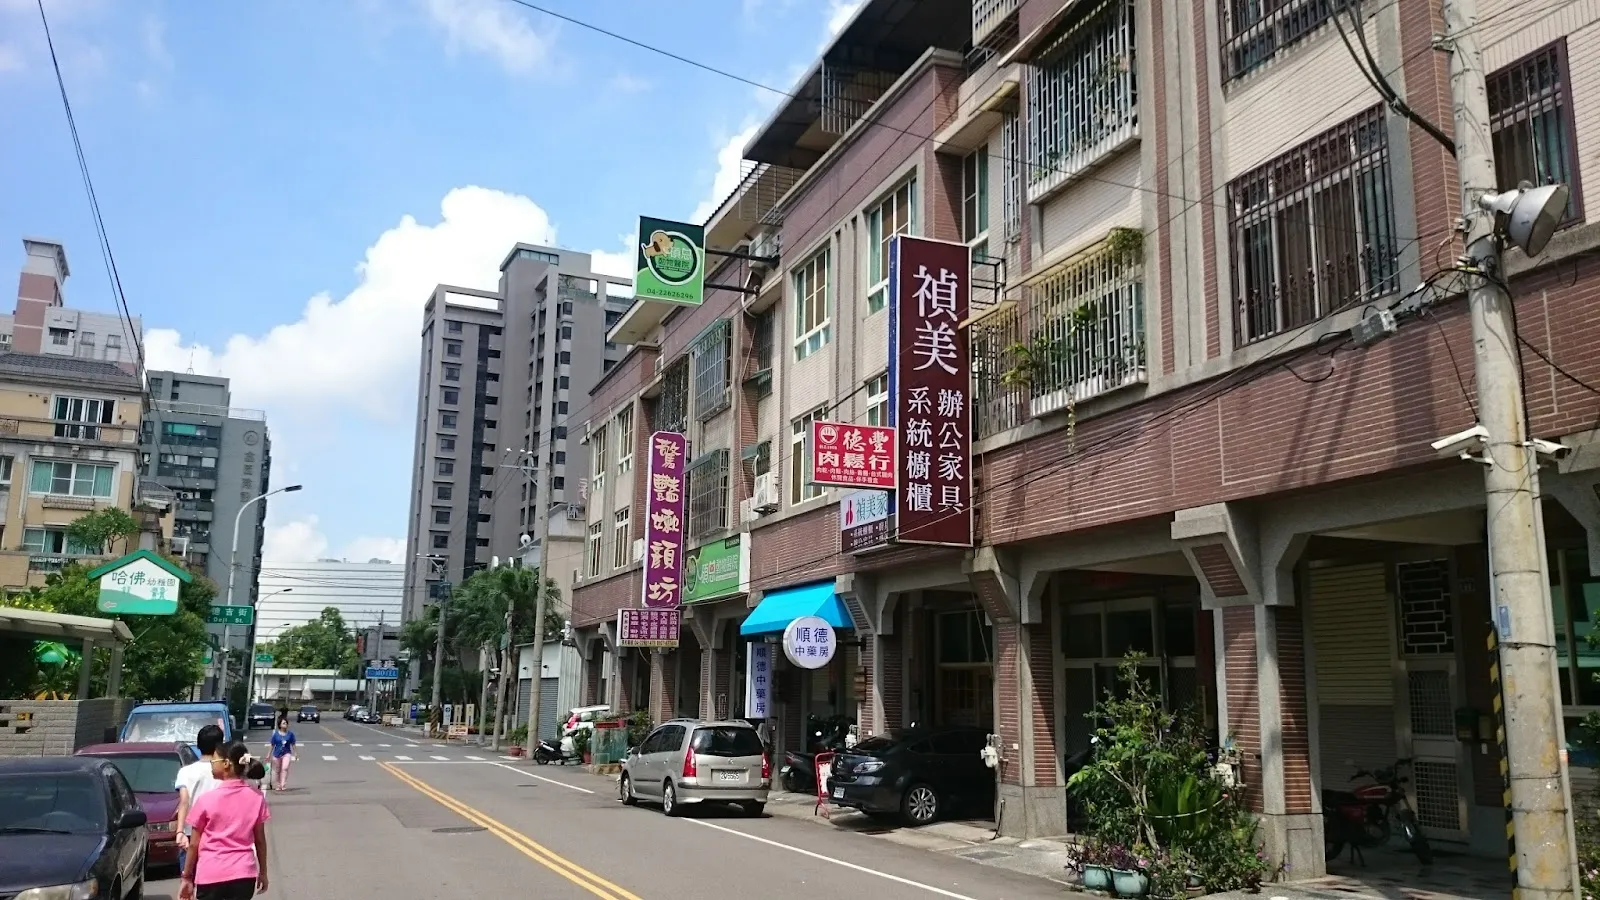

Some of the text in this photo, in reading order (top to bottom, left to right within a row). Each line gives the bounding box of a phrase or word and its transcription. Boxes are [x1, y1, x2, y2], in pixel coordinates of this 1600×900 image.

[912, 265, 958, 375] 禎美
[818, 451, 890, 471] 肉鬆行
[938, 389, 964, 514] 辦公家具
[795, 645, 829, 658] 中藥房
[796, 627, 828, 643] 順德
[755, 647, 766, 714] 順德中藥房
